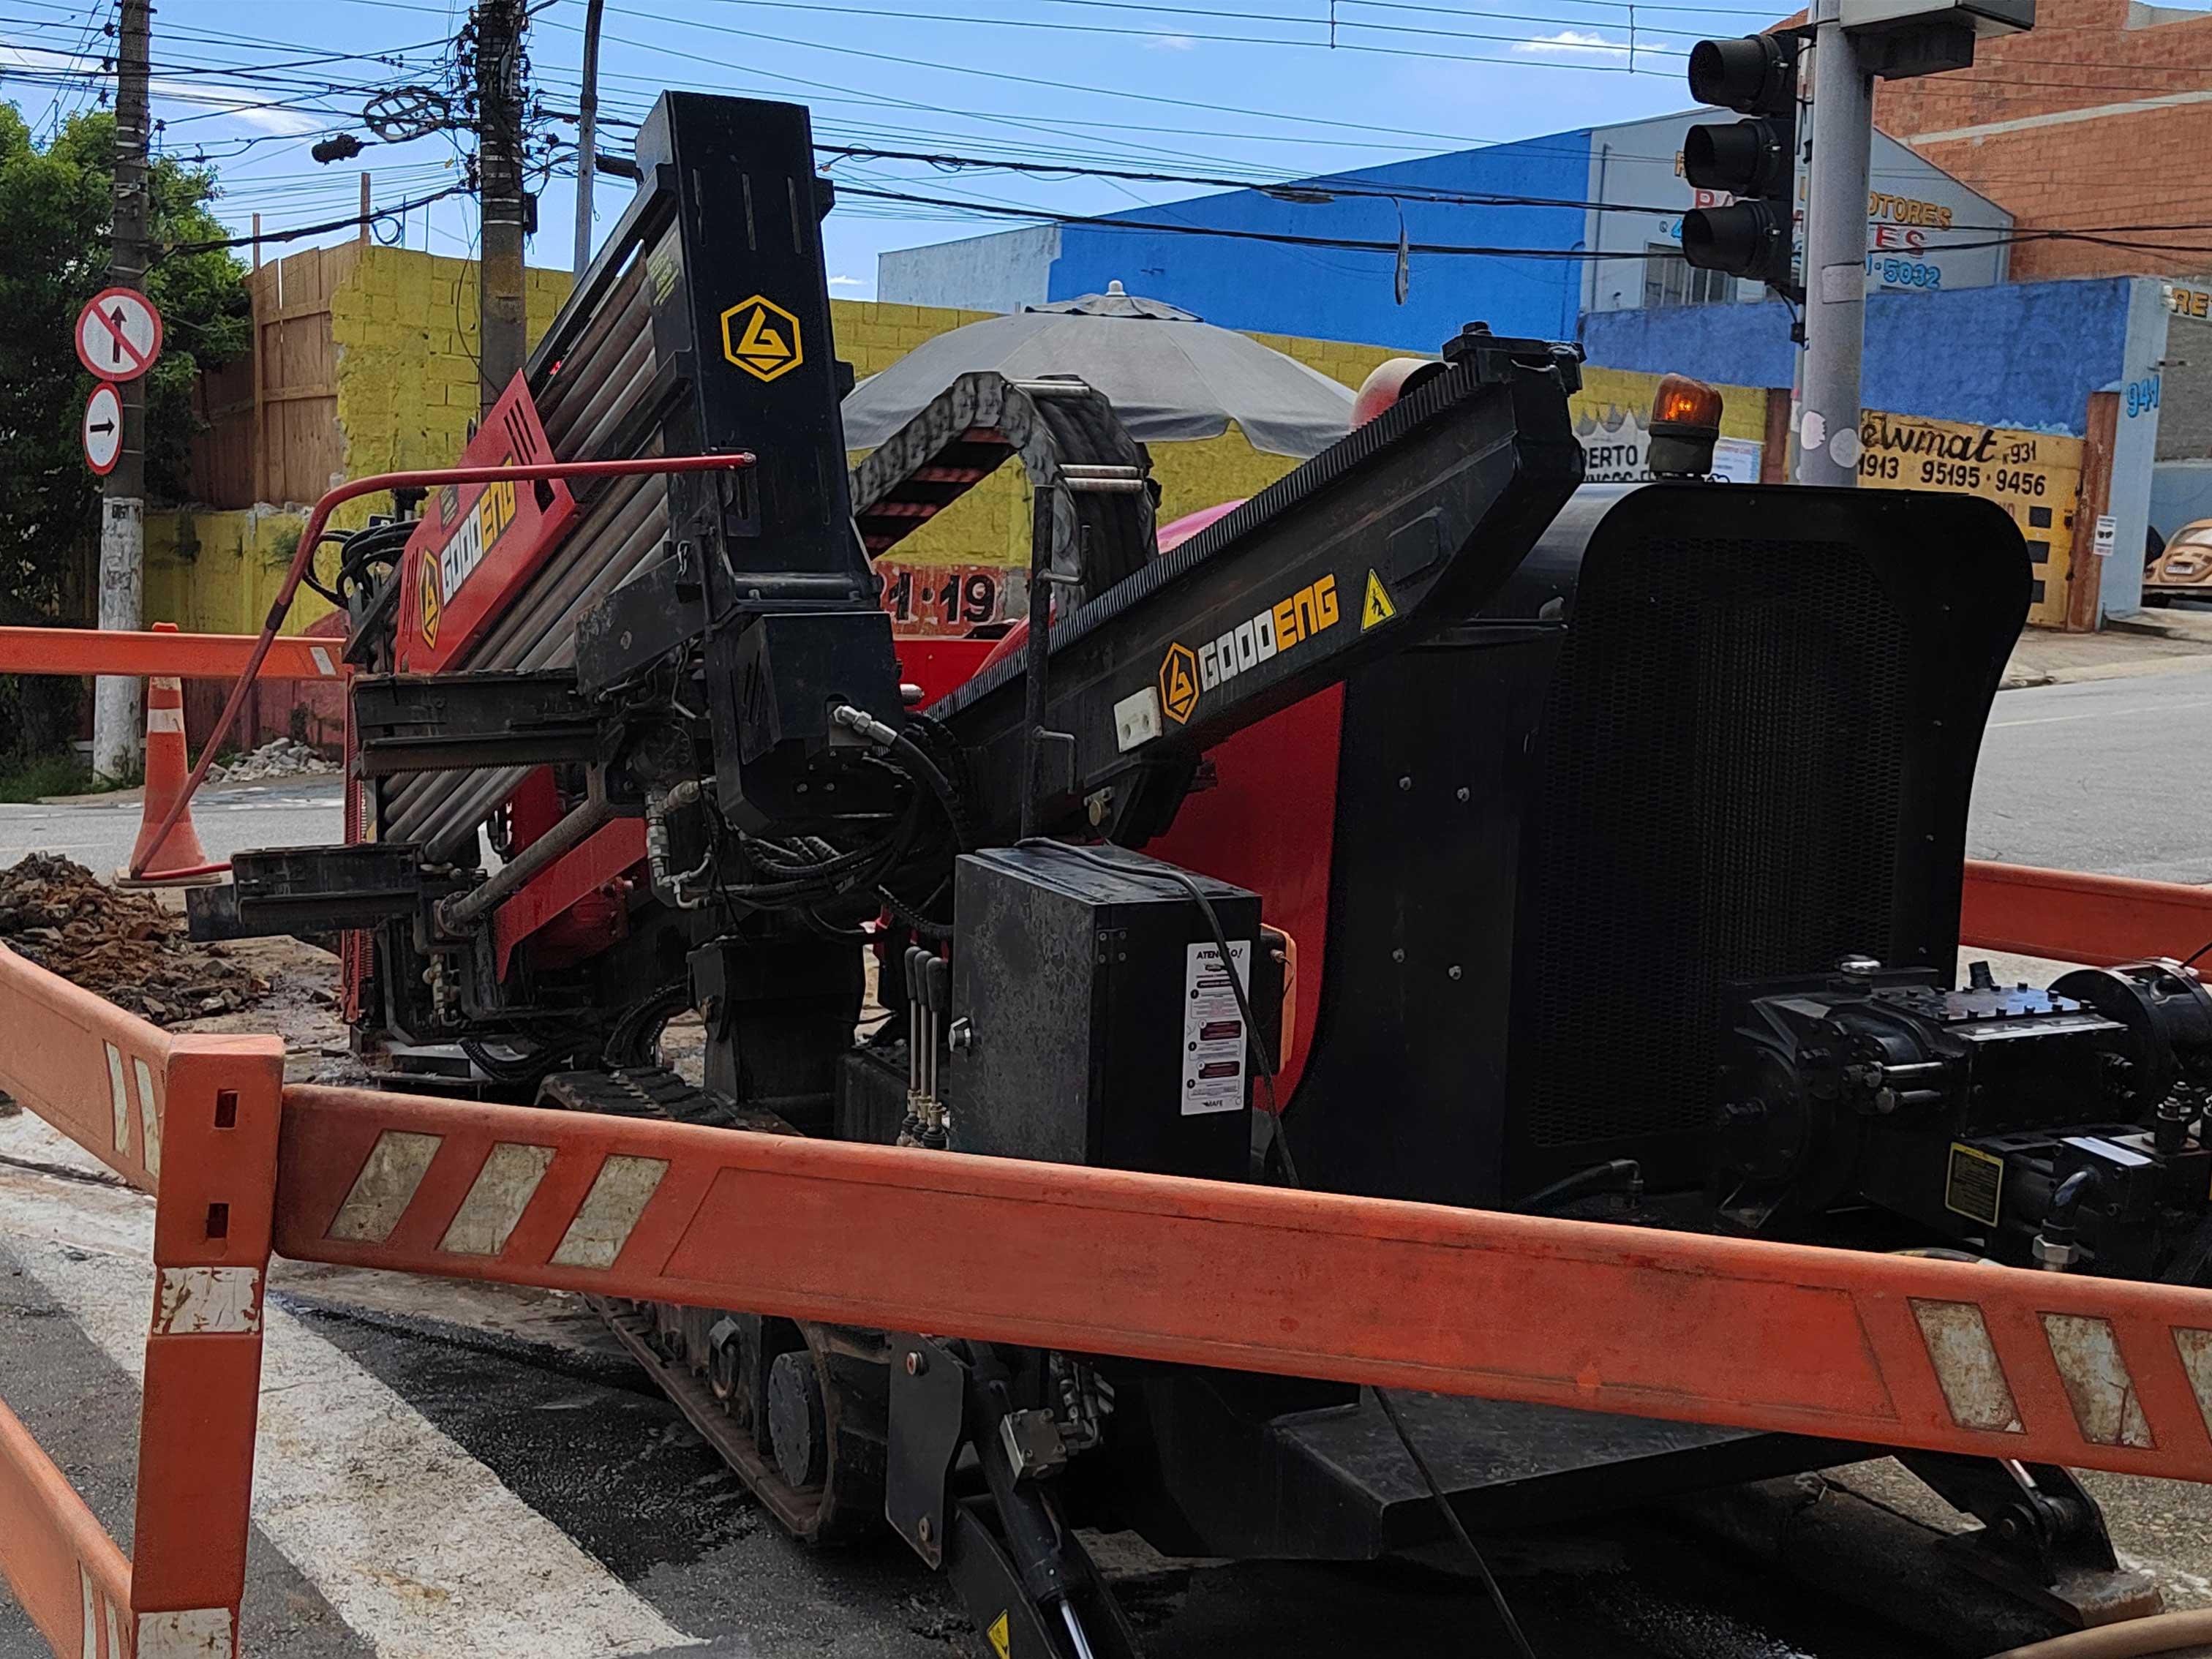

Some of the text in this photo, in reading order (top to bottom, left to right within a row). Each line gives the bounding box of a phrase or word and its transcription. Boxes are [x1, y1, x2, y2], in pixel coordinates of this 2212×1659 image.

[1867, 191, 1953, 231] OTORES
[2172, 287, 2212, 317] RE
[2126, 375, 2160, 418] 941
[1197, 573, 1340, 693] GOODENG
[1196, 948, 1244, 960] ATENO!
